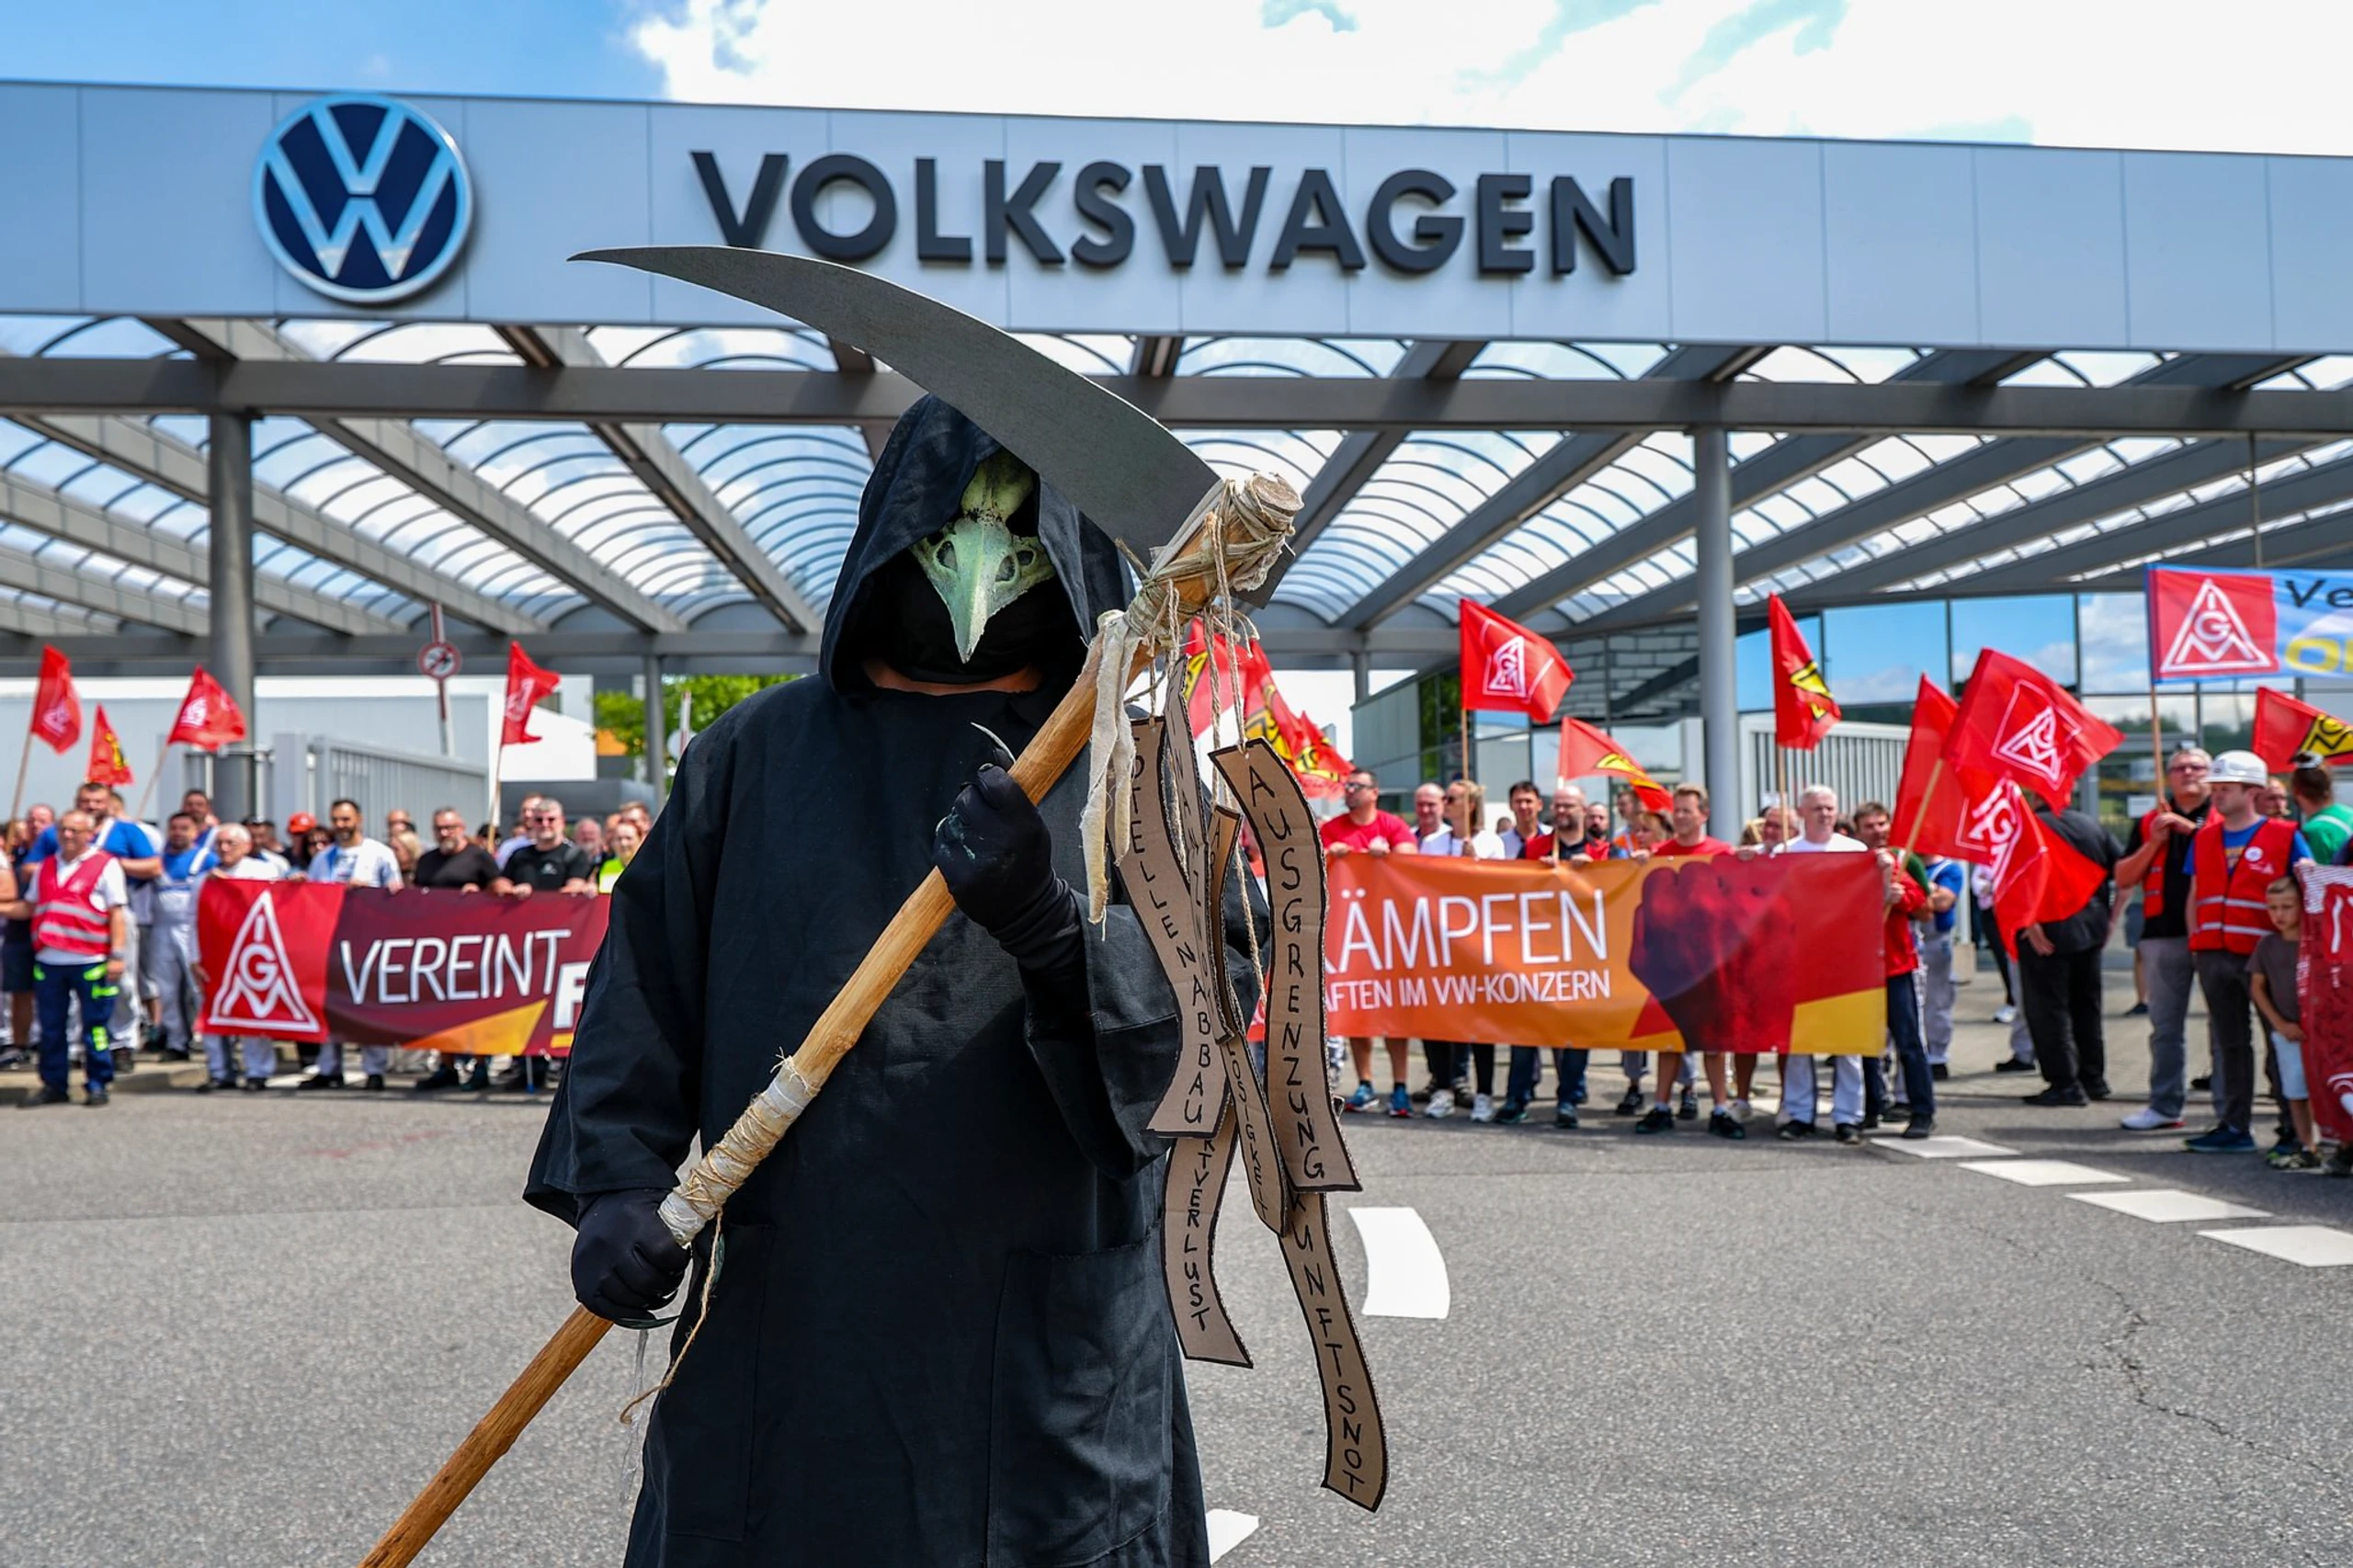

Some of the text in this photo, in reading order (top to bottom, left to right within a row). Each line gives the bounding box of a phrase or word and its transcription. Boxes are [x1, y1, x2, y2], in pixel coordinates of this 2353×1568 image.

[689, 151, 1635, 276] VOLKSWAGEN
[340, 928, 572, 1006] VEREINT
[1248, 764, 1325, 1180] AUSGRENZUNG
[1324, 888, 1608, 974] ÄMPFEN
[1398, 976, 1428, 1007] IM
[1431, 969, 1611, 1006] VW-KONZERN
